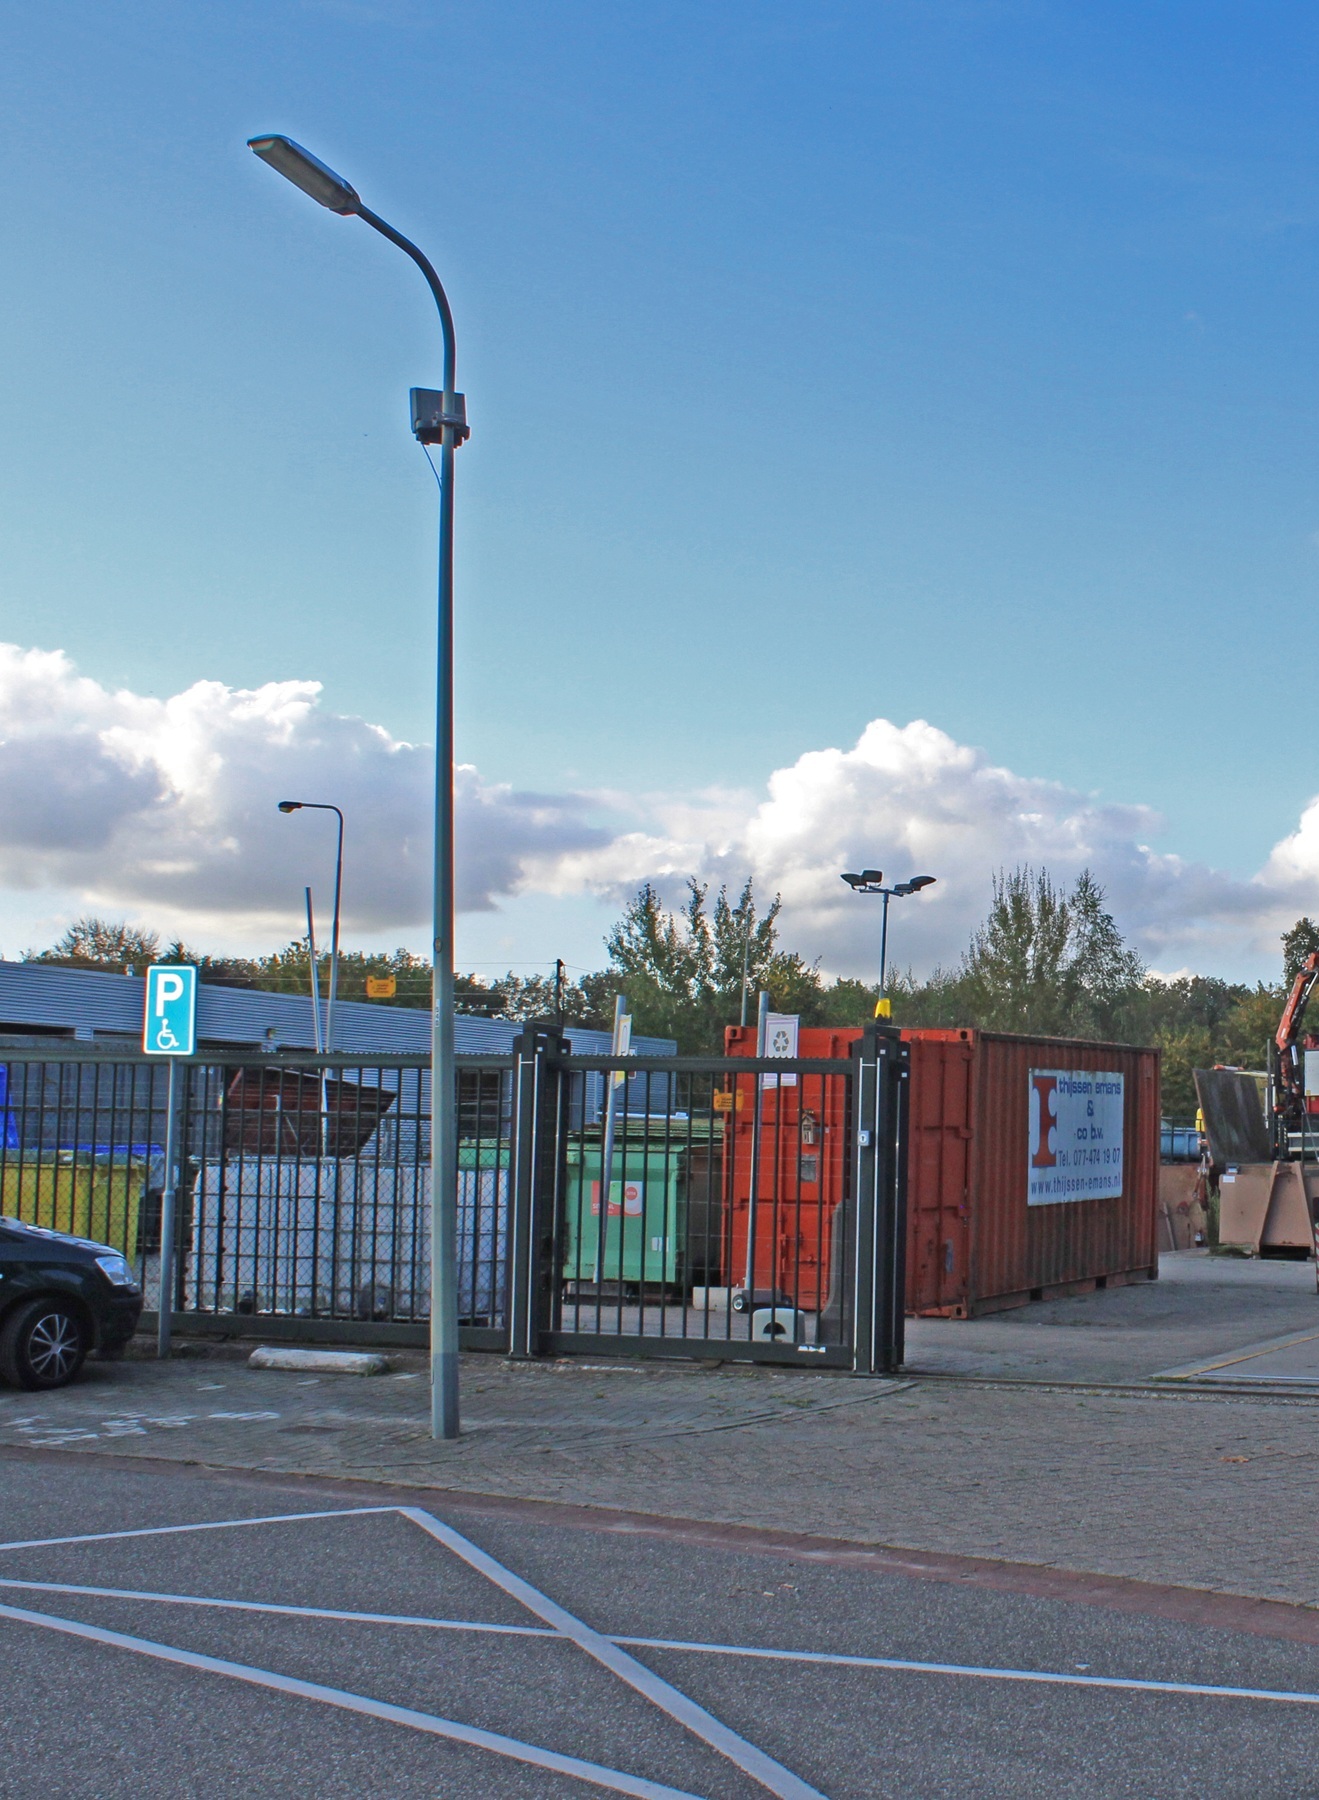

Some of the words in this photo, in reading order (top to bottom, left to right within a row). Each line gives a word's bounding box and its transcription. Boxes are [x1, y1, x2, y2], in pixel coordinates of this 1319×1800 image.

[155, 973, 184, 1017] P
[1059, 1077, 1092, 1097] thijssen
[1095, 1082, 1121, 1095] emans
[1087, 1100, 1094, 1117] &
[1077, 1127, 1087, 1140] co
[1091, 1124, 1104, 1140] b.v.
[1058, 1150, 1071, 1167] Tel.
[1073, 1148, 1100, 1166] 077-474
[1103, 1148, 1110, 1164] 19
[1112, 1148, 1120, 1163] 07
[1031, 1172, 1121, 1196] www.thijssen-emans.nl
